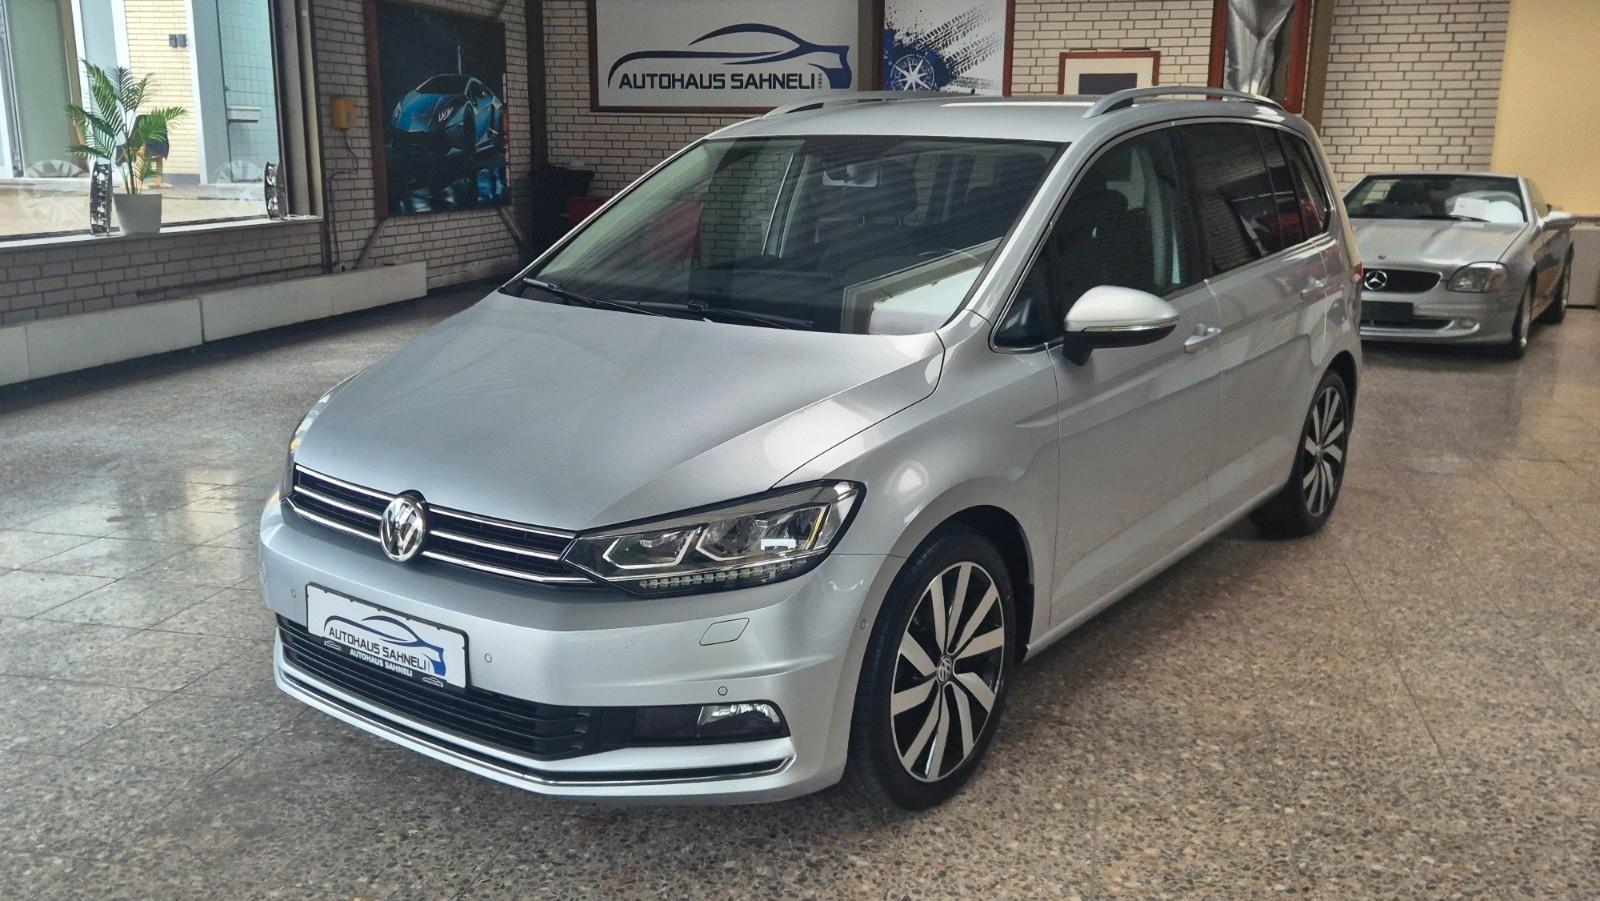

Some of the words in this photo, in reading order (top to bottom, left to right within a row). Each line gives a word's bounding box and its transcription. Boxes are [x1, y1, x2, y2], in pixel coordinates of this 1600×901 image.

[618, 73, 726, 90] AUTOHAUS
[730, 73, 815, 90] SAHNELI
[328, 627, 380, 655] AUTOHAUS
[382, 647, 427, 671] SAHNELI
[349, 649, 384, 667] AUTOHAUS
[384, 660, 413, 678] SAHNELI
